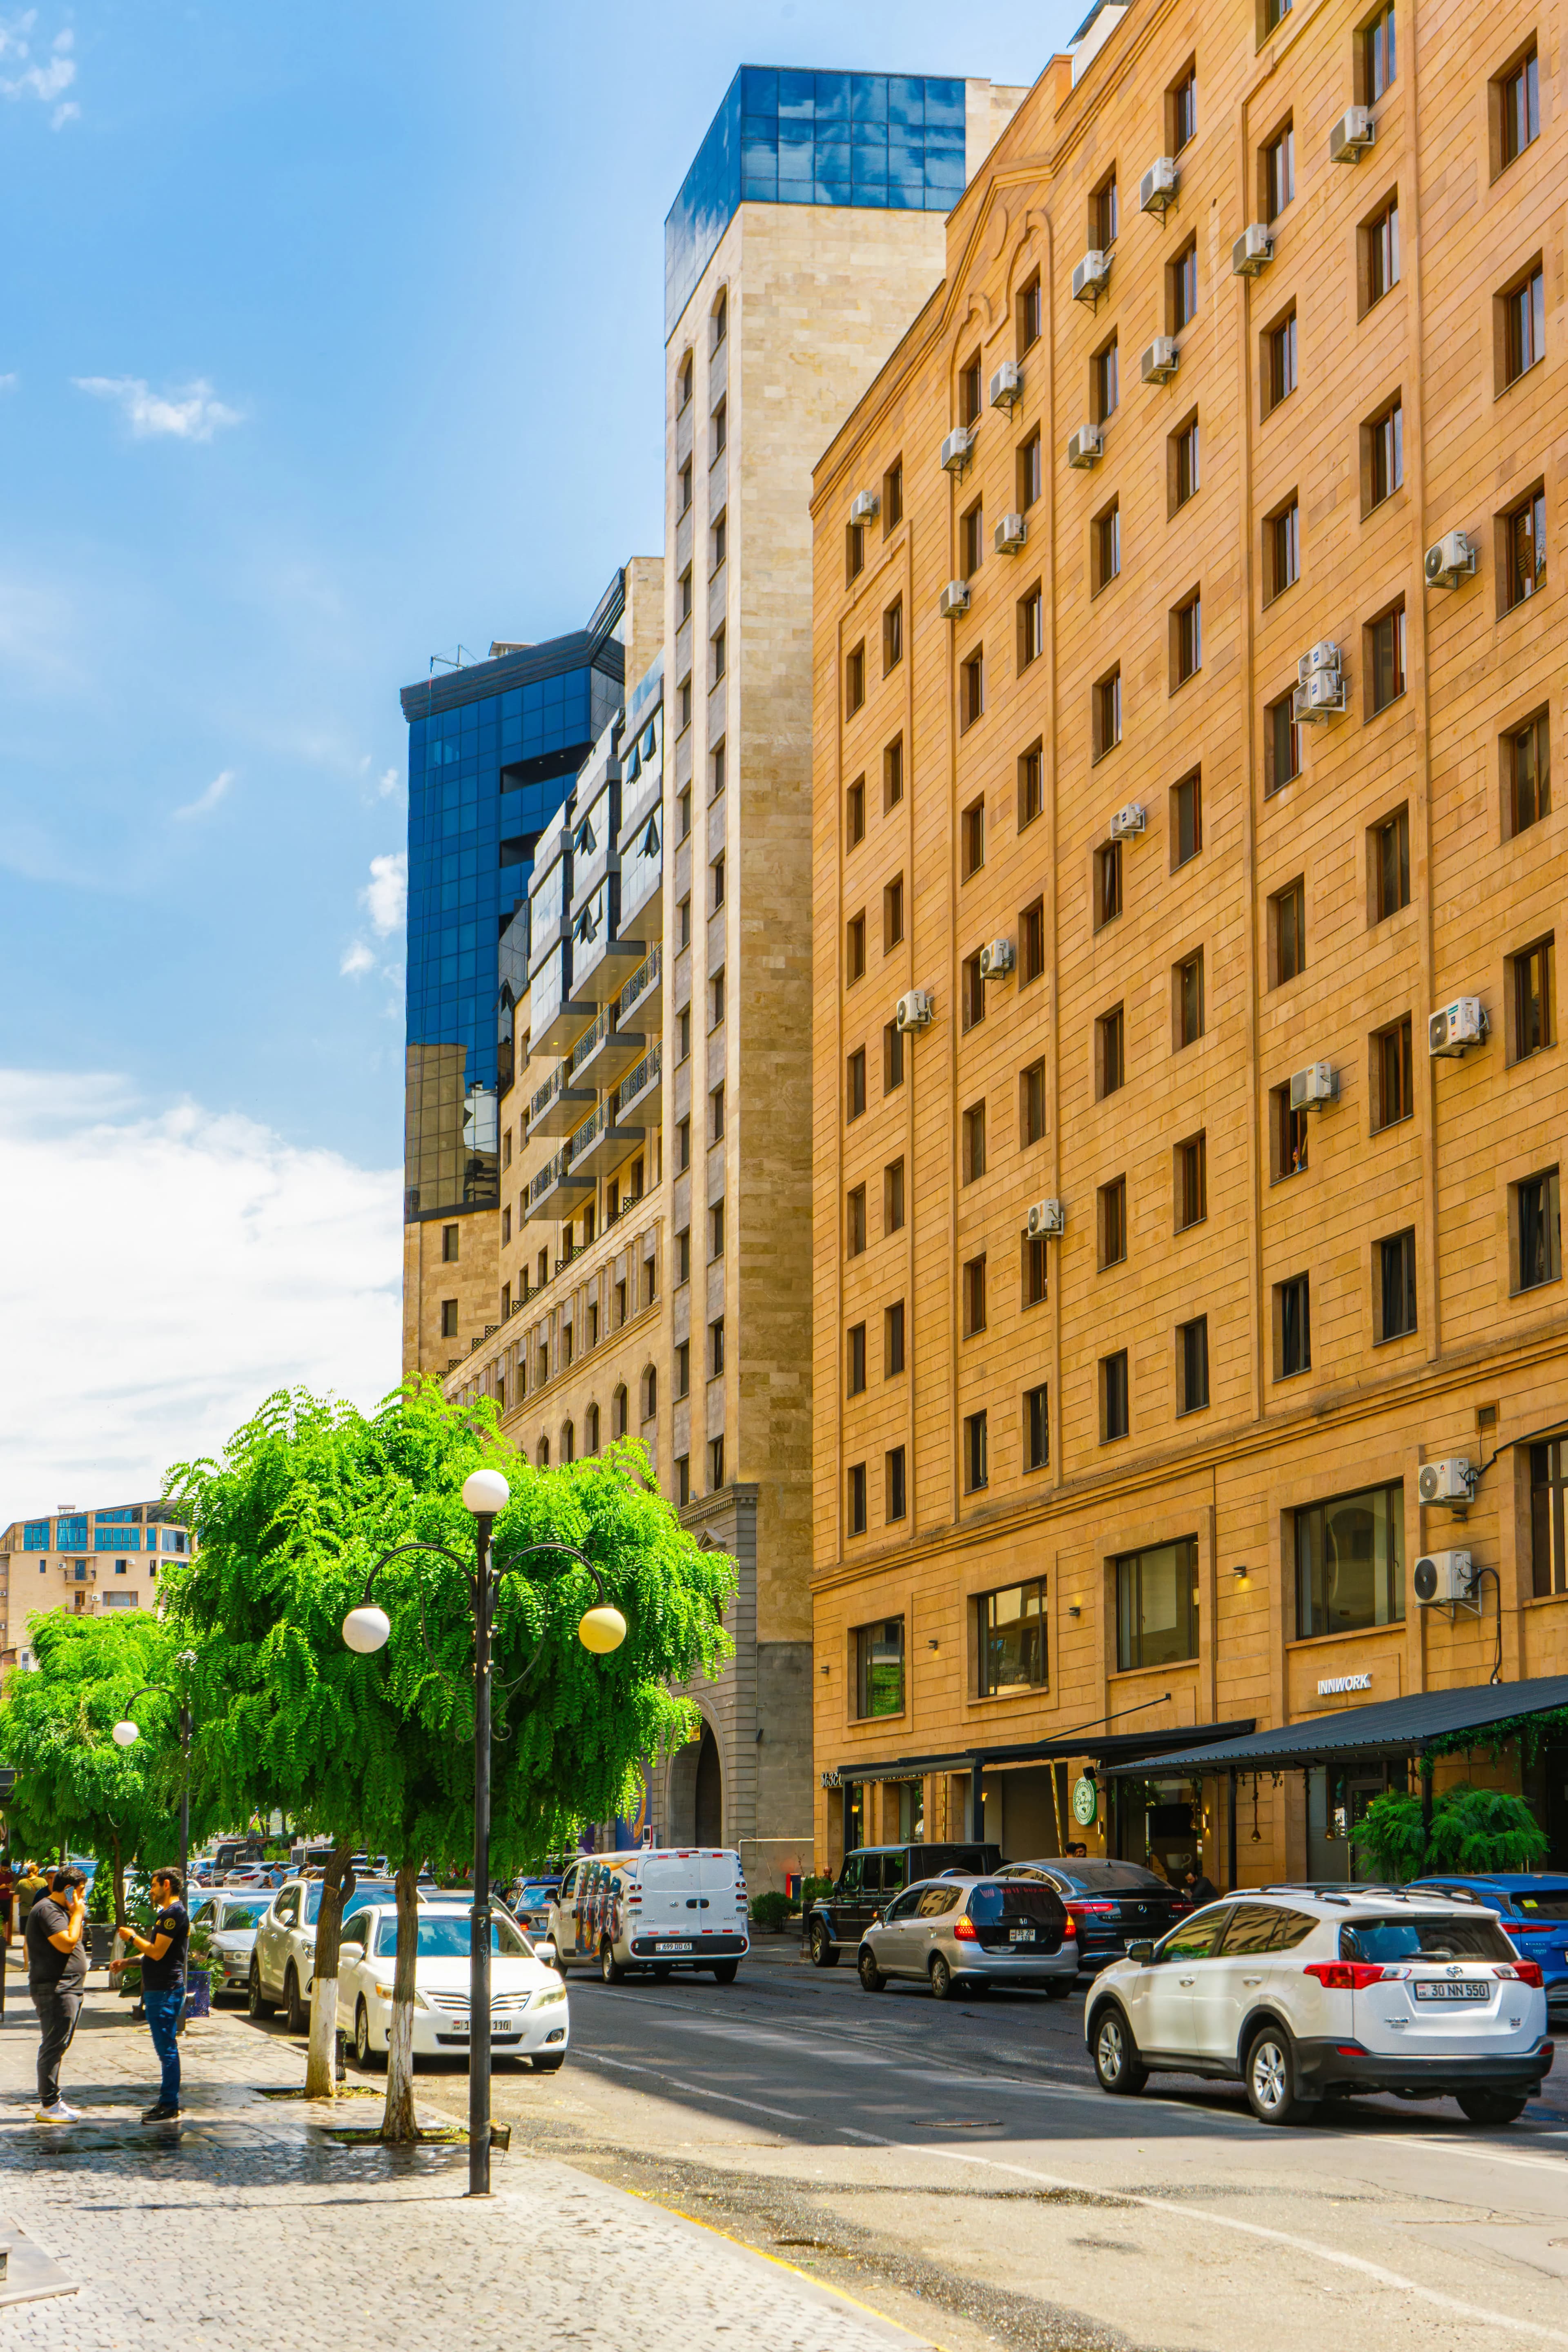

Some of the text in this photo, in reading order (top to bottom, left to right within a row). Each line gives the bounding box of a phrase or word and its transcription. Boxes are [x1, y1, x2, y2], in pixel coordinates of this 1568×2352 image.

[1318, 1673, 1372, 1695] INNWORK
[1431, 1984, 1445, 1997] 30
[1448, 1984, 1464, 1996] NN
[1466, 1984, 1486, 1997] 550
[464, 2020, 470, 2030] 1
[493, 2020, 509, 2030] 110
